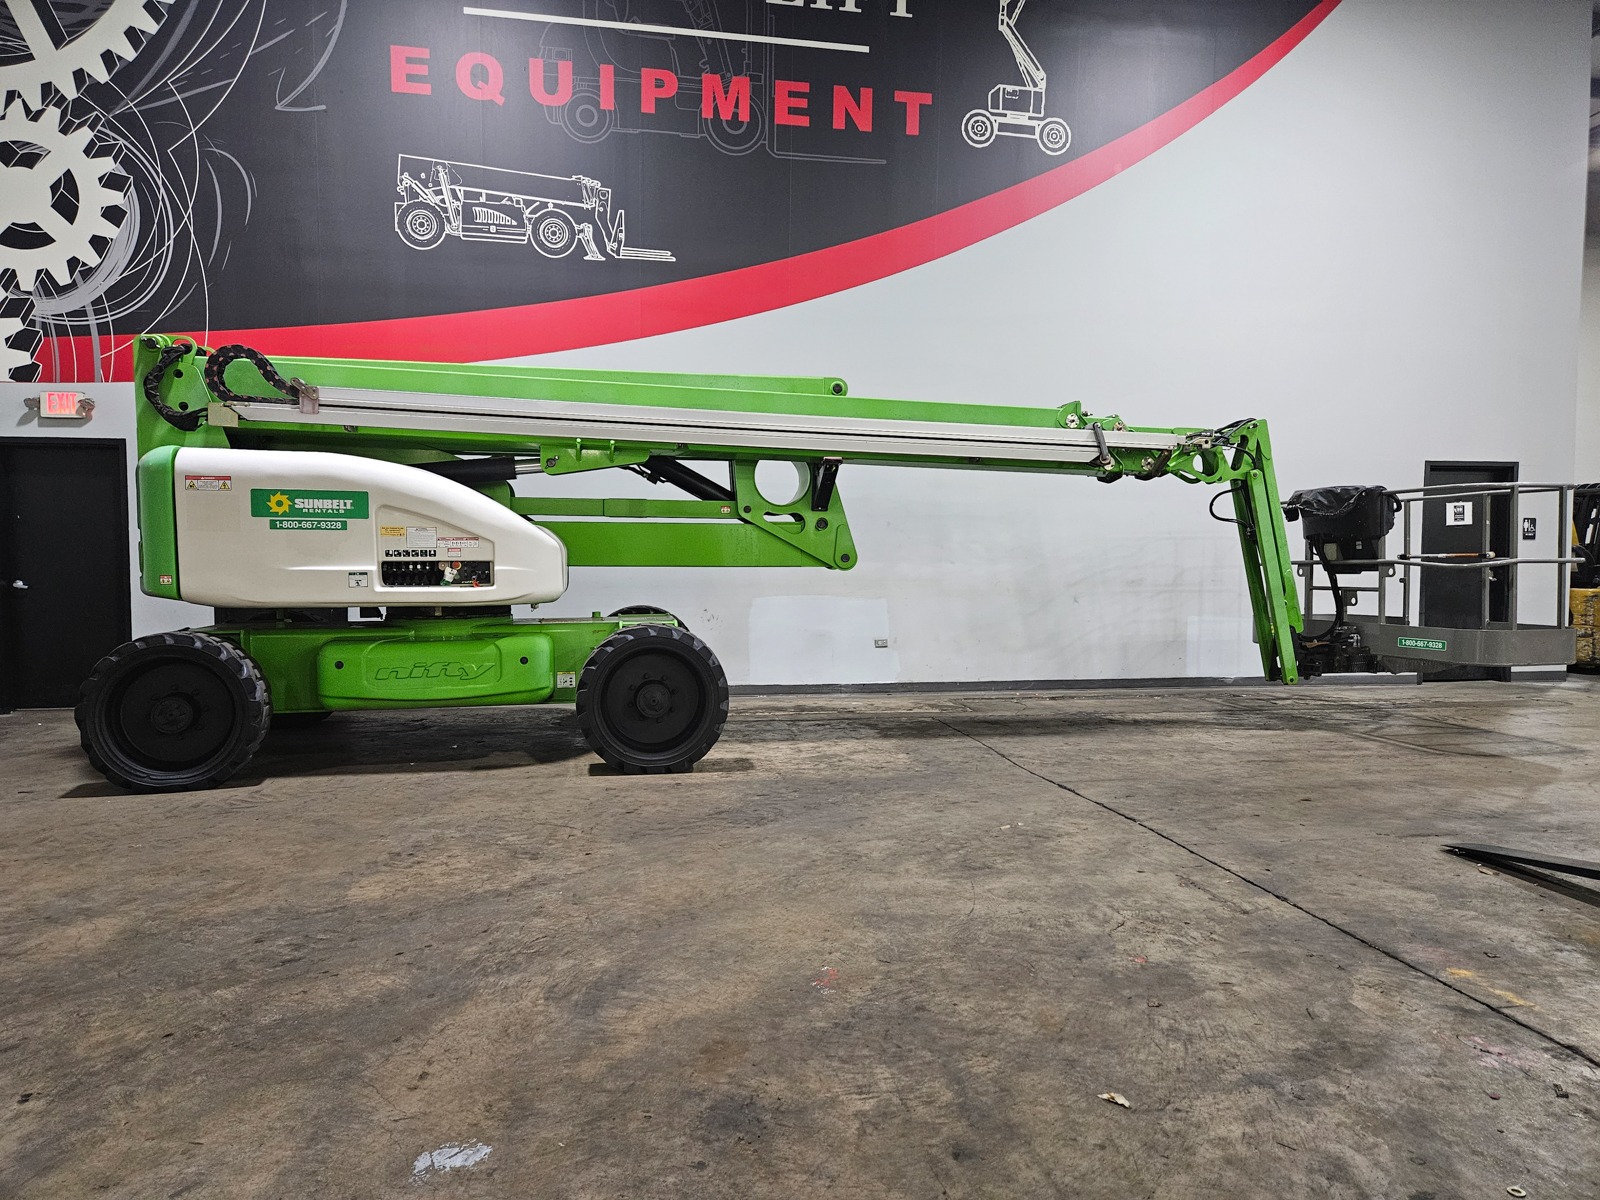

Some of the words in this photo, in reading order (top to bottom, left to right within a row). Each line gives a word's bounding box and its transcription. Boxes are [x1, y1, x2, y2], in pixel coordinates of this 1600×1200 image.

[389, 45, 933, 136] EQUIPMENT
[47, 392, 77, 415] EXIT
[294, 498, 353, 510] SUNBELT
[275, 520, 341, 529] 1-800-667-9328
[1401, 639, 1443, 649] 1-800-667-9328
[375, 661, 495, 681] nifty
